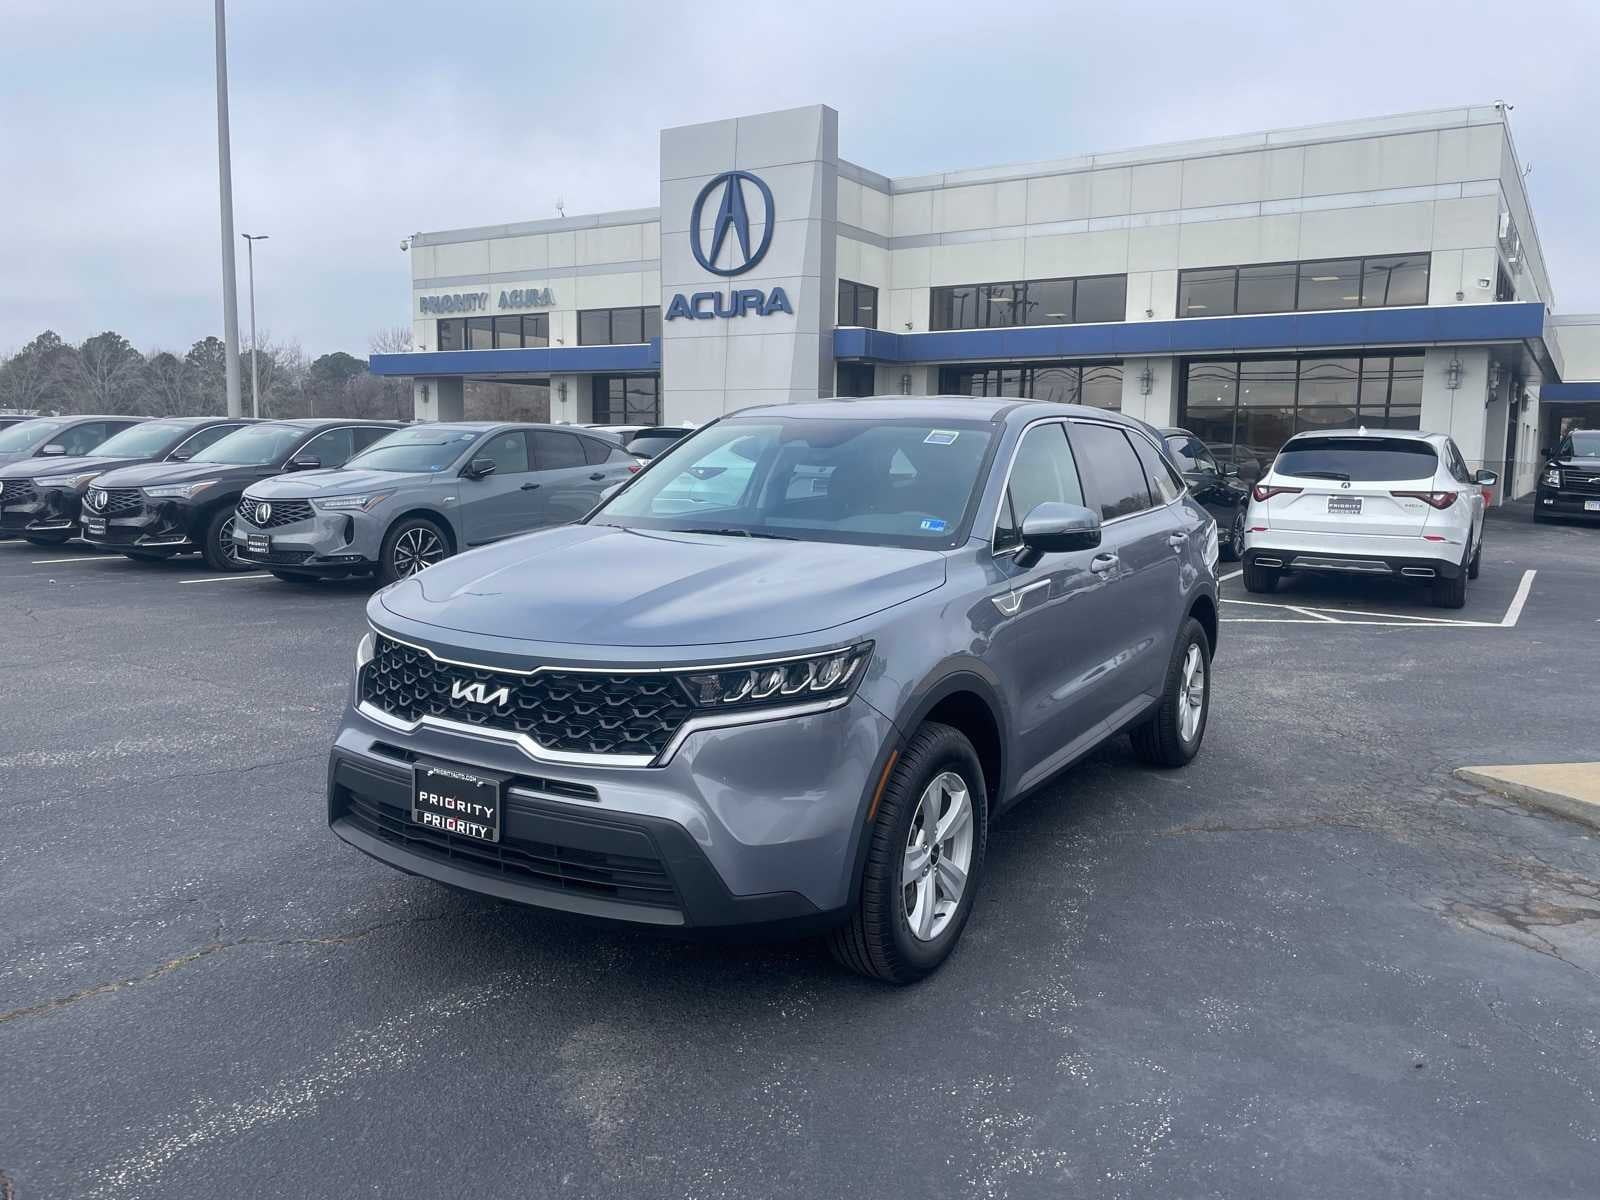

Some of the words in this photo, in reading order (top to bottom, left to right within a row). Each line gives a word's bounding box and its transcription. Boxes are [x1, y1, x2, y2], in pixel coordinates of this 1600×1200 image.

[419, 292, 488, 314] PRIORITY
[498, 287, 554, 309] ACURA
[664, 286, 792, 321] ACURA
[419, 791, 494, 818] PRIORITY
[423, 812, 488, 838] PRIORITY
